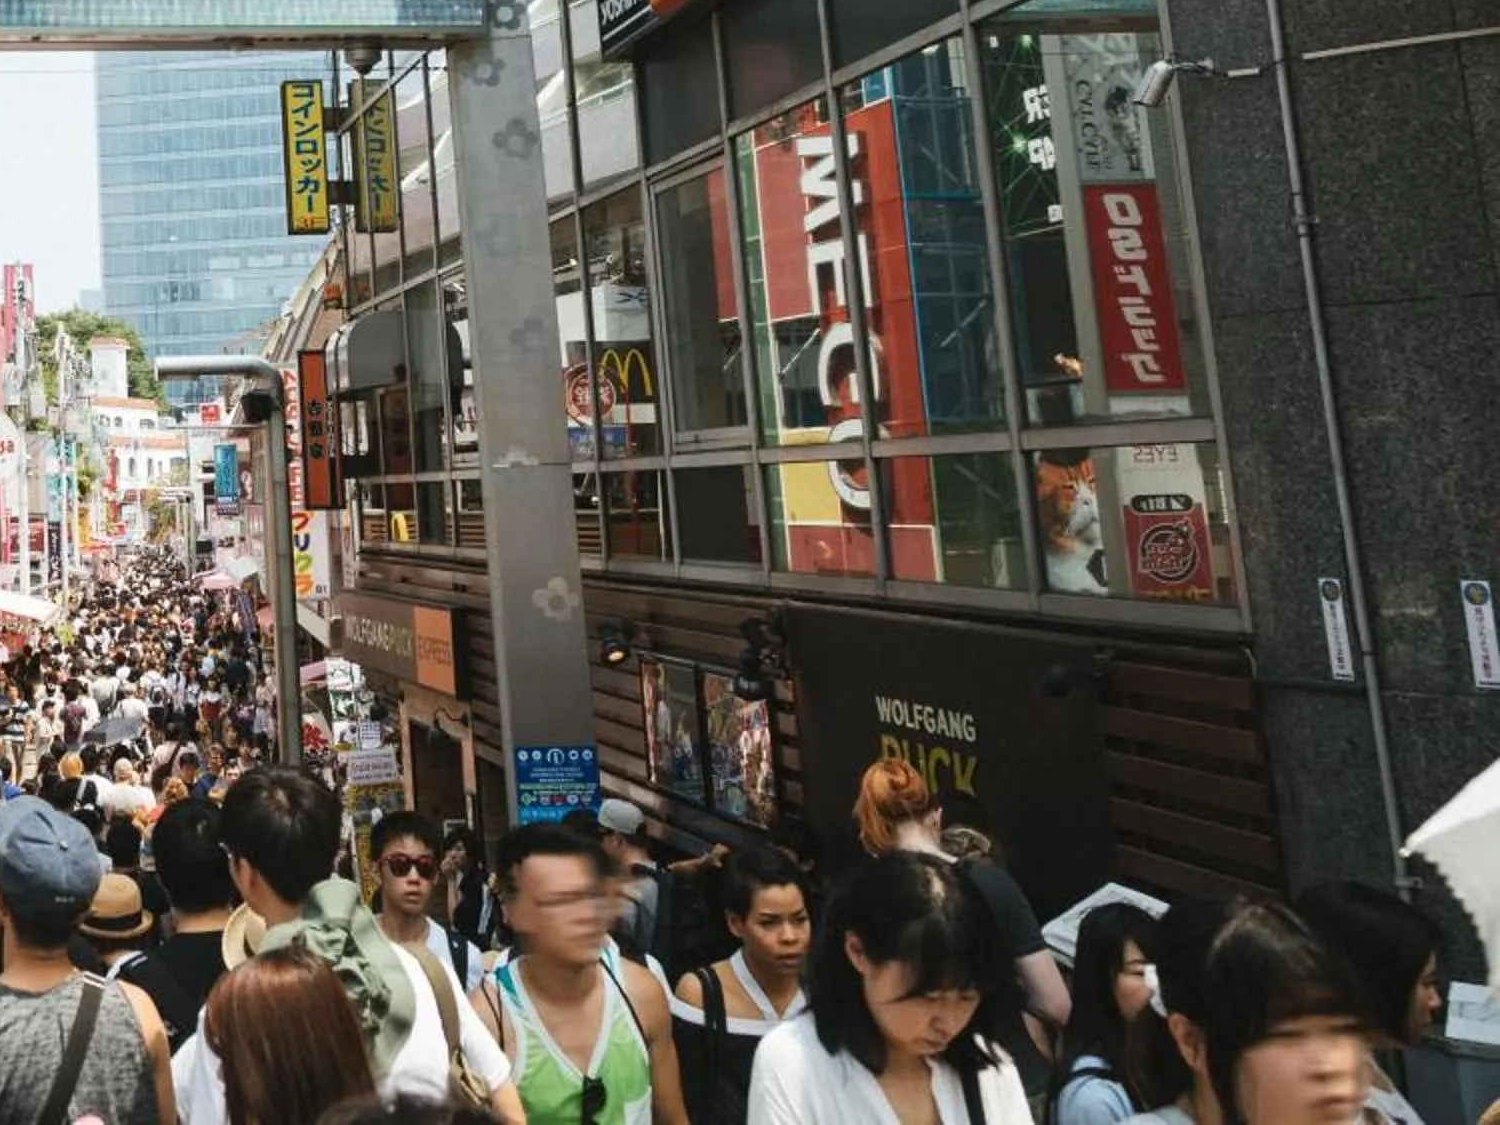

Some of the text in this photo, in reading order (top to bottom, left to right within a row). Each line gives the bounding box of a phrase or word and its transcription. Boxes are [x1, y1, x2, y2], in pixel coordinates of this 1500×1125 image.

[291, 83, 323, 213] コインロッカー
[875, 695, 977, 743] WOLFGANG
